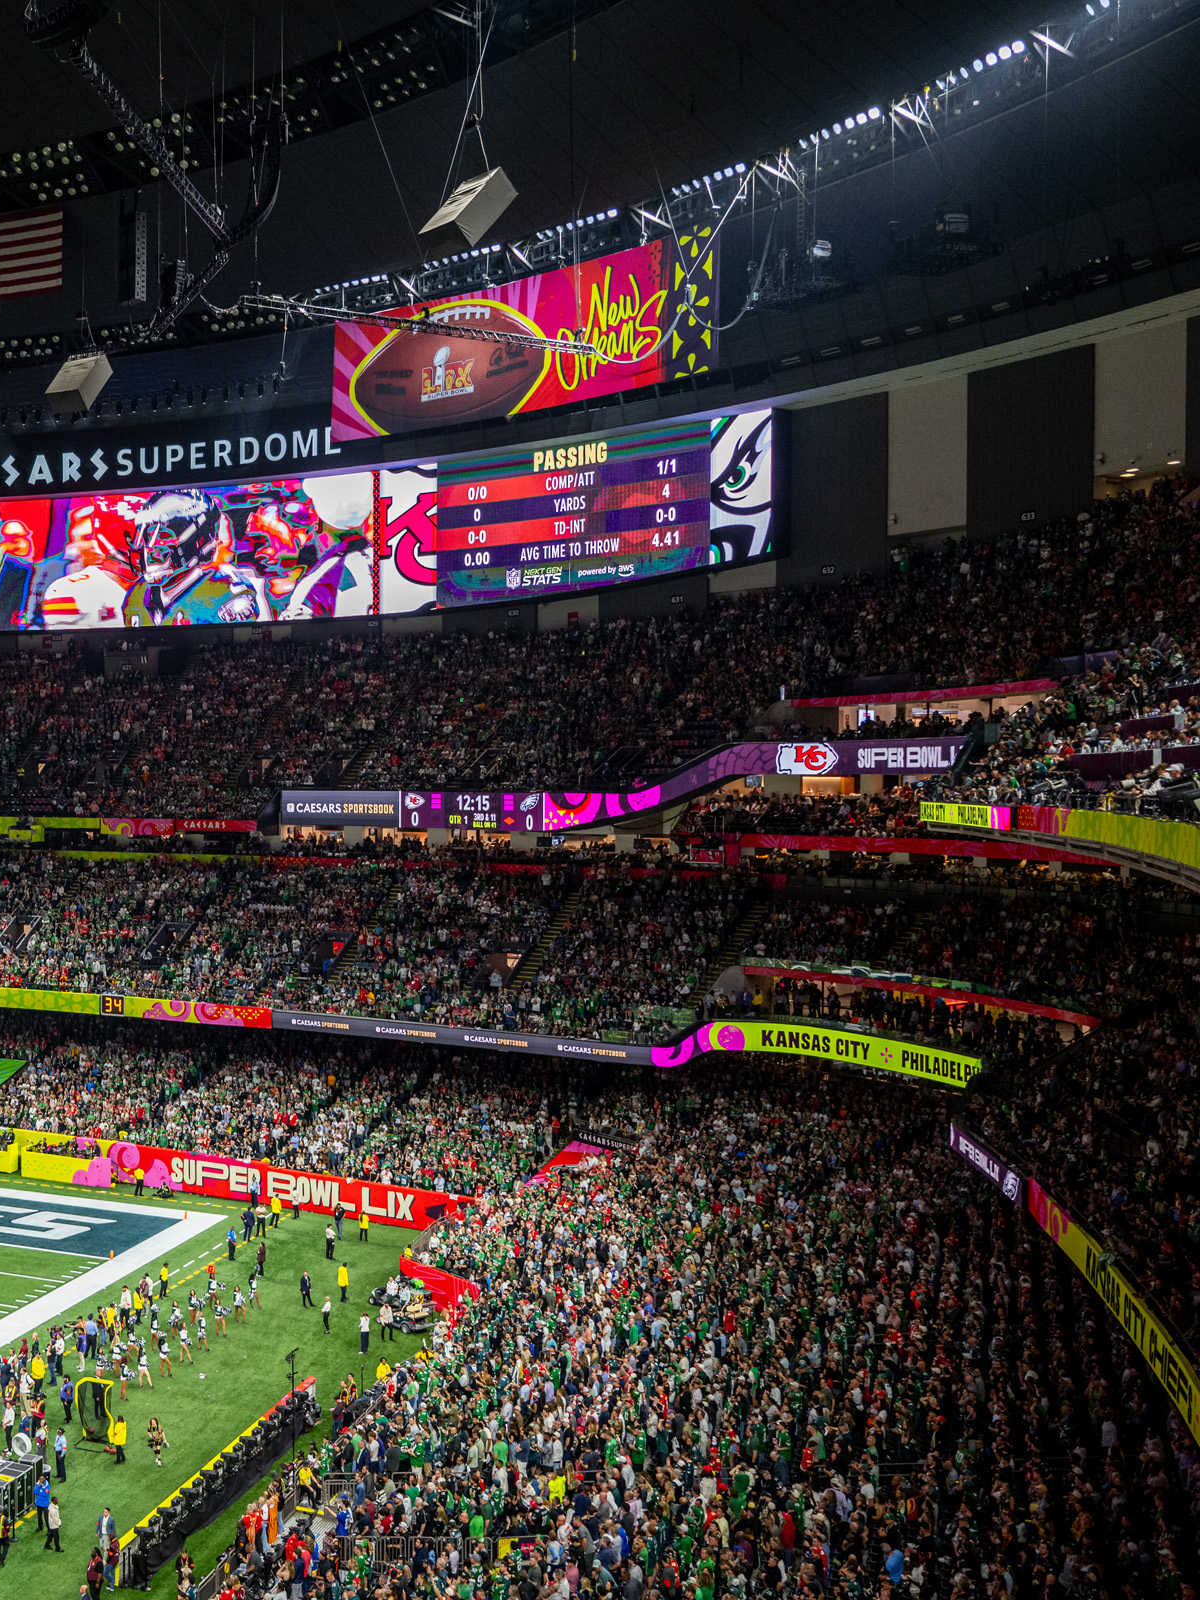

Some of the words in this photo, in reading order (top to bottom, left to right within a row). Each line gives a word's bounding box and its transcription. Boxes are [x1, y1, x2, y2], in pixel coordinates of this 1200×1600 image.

[584, 266, 640, 344] New
[427, 391, 449, 400] SUPER
[450, 387, 468, 395] BOWL
[533, 441, 608, 473] PASSING
[467, 485, 488, 501] 0/0
[545, 471, 595, 492] COMP/ATT
[656, 458, 678, 476] 1/1
[473, 508, 482, 522] 0
[553, 495, 586, 513] YARDS
[662, 483, 671, 499] 4
[1021, 512, 1035, 521] 633
[467, 530, 487, 545] 0-0
[553, 518, 586, 536] TD-INT
[656, 506, 677, 523] 0-0
[464, 551, 491, 567] 0.00
[520, 547, 541, 562] AVG
[543, 544, 566, 559] TIME
[568, 542, 582, 557] TO
[584, 537, 620, 555] THROW
[651, 530, 680, 548] 4.41
[524, 566, 543, 575] NEXT
[545, 565, 563, 575] GEN
[577, 566, 607, 578] powered
[608, 566, 617, 577] by
[618, 563, 635, 574] aws
[822, 566, 835, 574] 632
[522, 573, 562, 586] STATS
[671, 596, 683, 604] 631
[857, 747, 904, 769] SUPER
[906, 746, 950, 768] BOWL
[296, 802, 341, 814] CAESARS
[343, 803, 394, 815] SPORTSBOOK
[456, 795, 490, 811] 12:15
[411, 811, 419, 827] 0
[449, 815, 462, 825] QTR
[463, 815, 468, 825] 1
[473, 813, 485, 821] 3RD
[490, 812, 496, 821] 11
[525, 814, 533, 830] 0
[183, 819, 227, 831] CAESARS
[473, 821, 484, 829] BALL
[105, 997, 122, 1014] 34
[296, 1019, 321, 1028] CAESARS
[381, 1027, 406, 1036] CAESARS
[469, 1035, 497, 1044] CAESARS
[761, 1029, 830, 1053] KANSAS
[835, 1038, 870, 1060] CITY
[563, 1045, 592, 1054] CAESARS
[578, 1132, 610, 1146] CAESARS
[170, 1156, 261, 1197] SUPER
[267, 1170, 356, 1213] BOWL
[361, 1186, 415, 1222] LIX
[1086, 1245, 1121, 1318] KANSAS
[1123, 1294, 1147, 1351] CITY
[1149, 1328, 1193, 1425] CHIEFS
